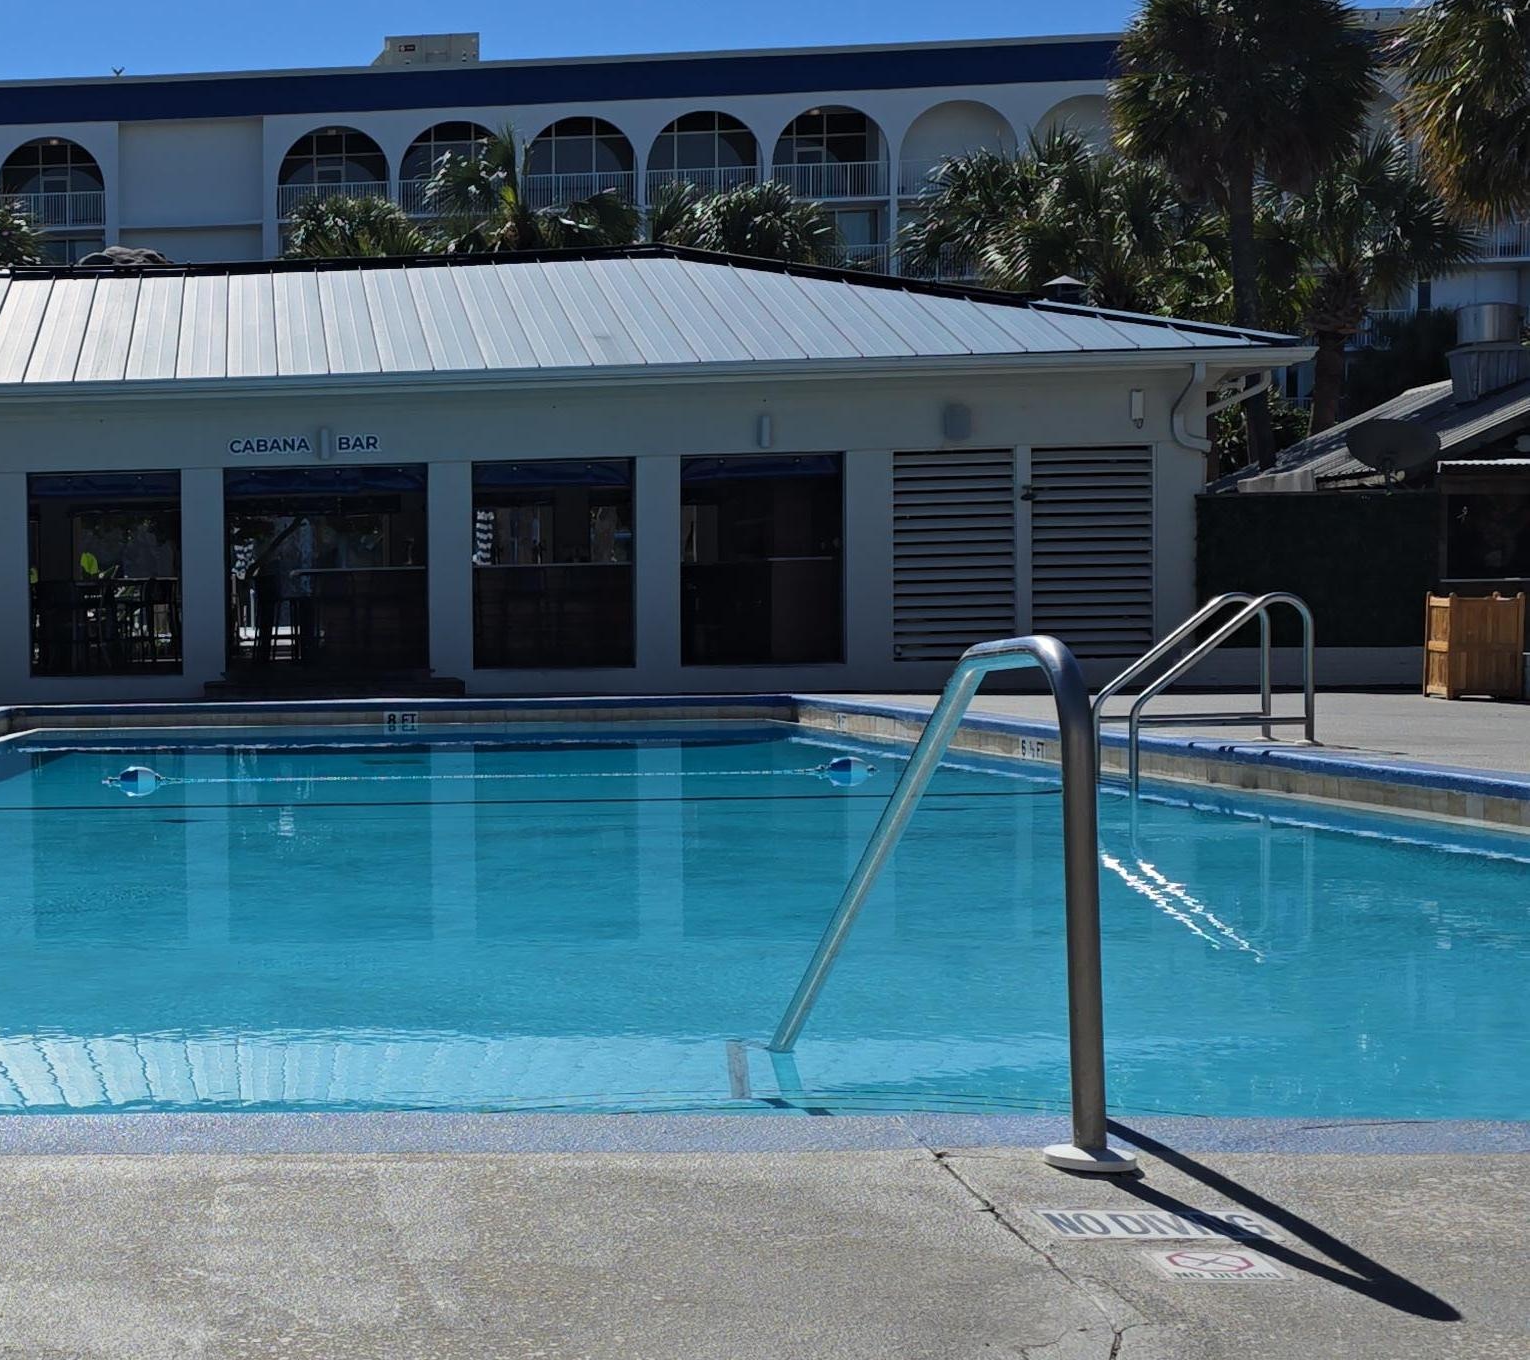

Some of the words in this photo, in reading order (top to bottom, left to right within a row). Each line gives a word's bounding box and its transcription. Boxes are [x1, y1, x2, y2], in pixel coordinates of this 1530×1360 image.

[229, 437, 310, 454] CABANA
[338, 436, 378, 451] BAR
[1021, 740, 1026, 756] 6
[1043, 1213, 1111, 1235] NO
[1109, 1213, 1274, 1236] DIVING
